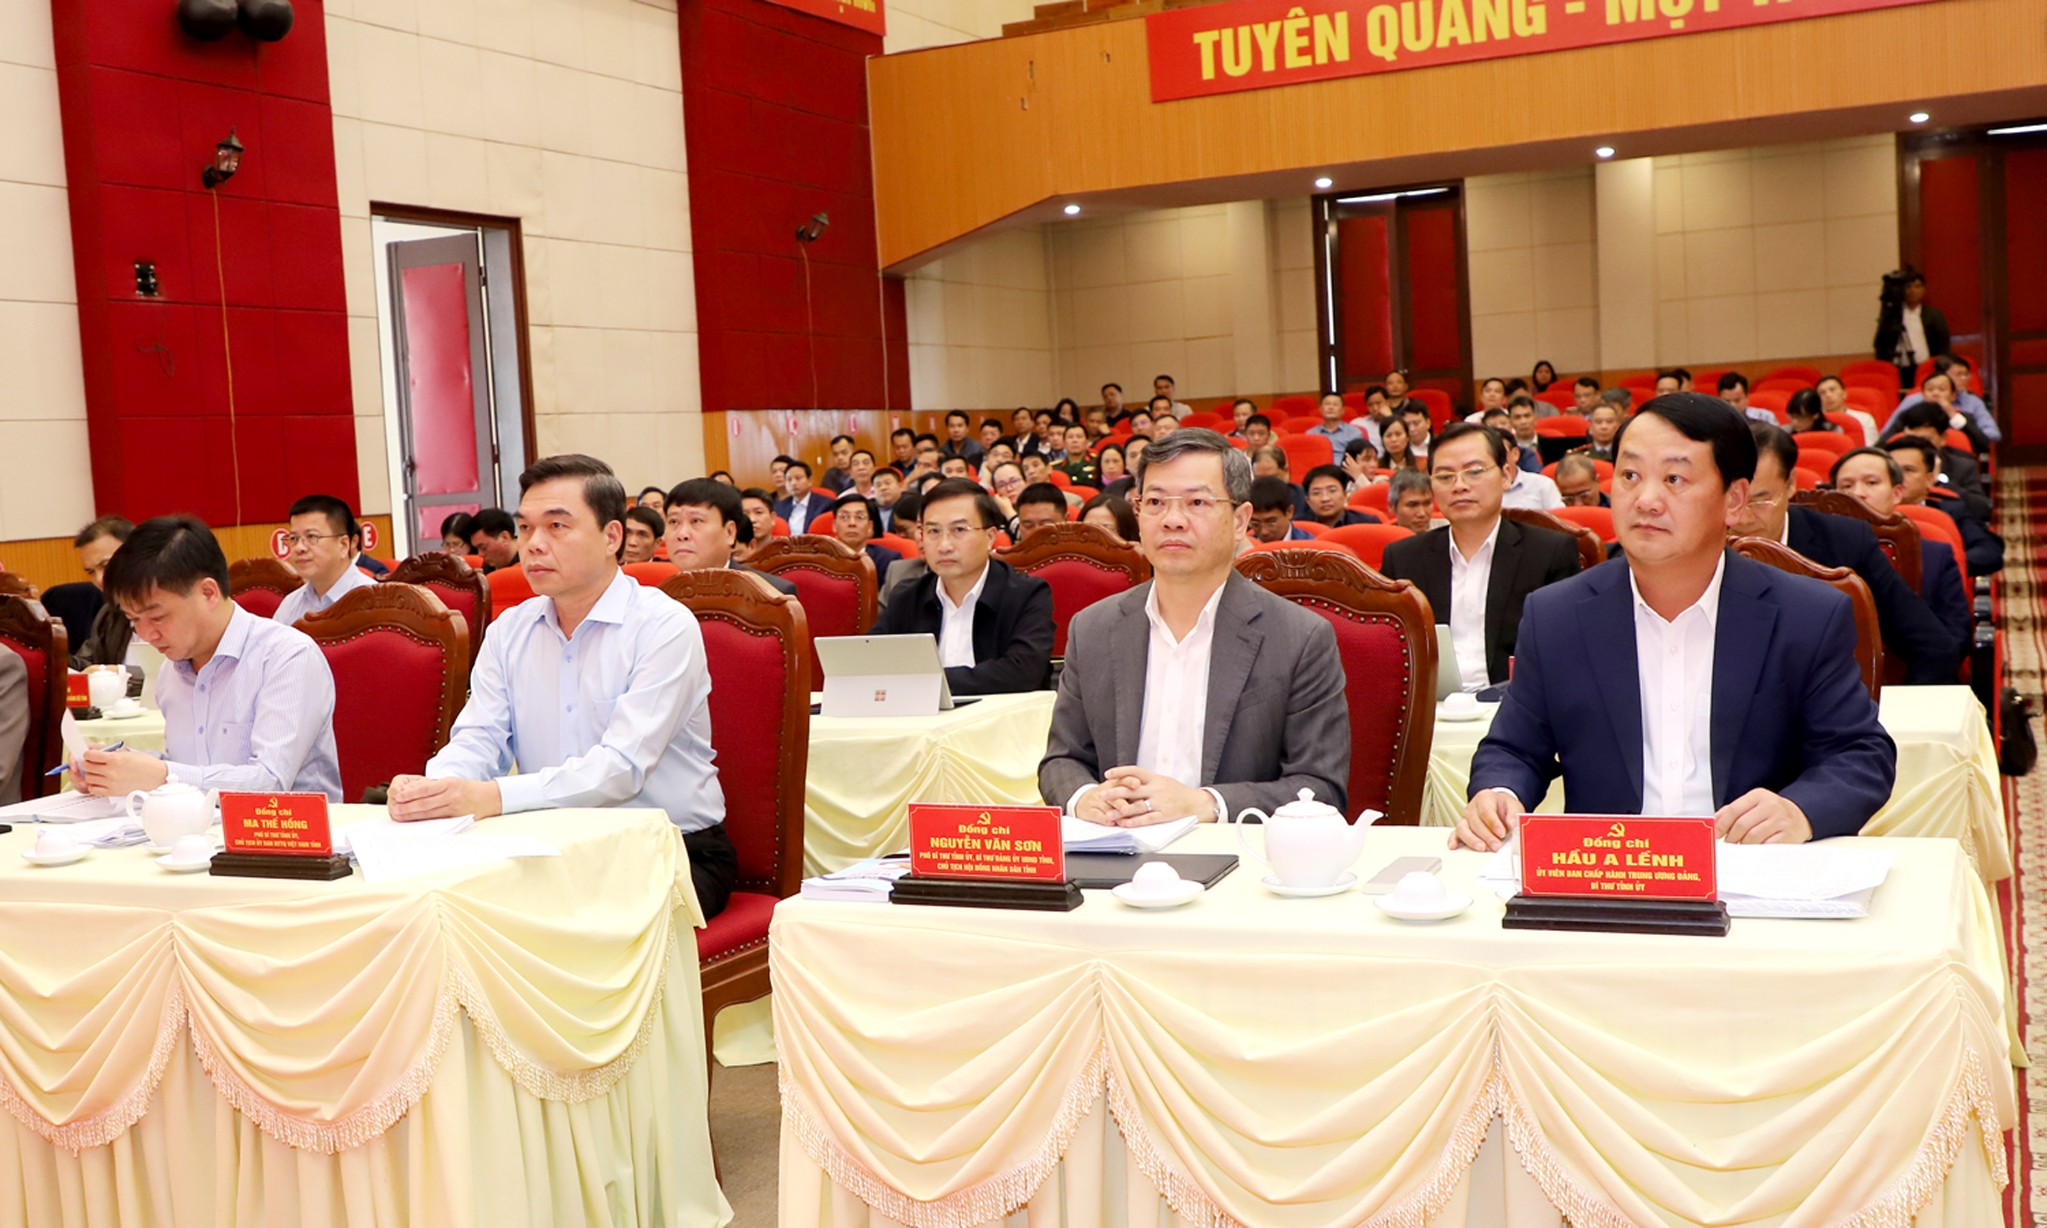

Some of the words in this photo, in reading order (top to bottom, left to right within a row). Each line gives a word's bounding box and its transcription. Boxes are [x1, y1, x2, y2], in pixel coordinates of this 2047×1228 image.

[1193, 6, 1350, 80] TUYÊN
[1366, 0, 1547, 62] QUANG
[363, 526, 373, 547] E
[243, 818, 259, 828] MA
[261, 816, 279, 829] THẾ
[991, 826, 1010, 835] chí
[930, 834, 981, 850] NGUYỄN
[984, 837, 1011, 851] VĂN
[1014, 840, 1042, 852] SƠN
[1625, 838, 1650, 848] chí
[1552, 848, 1597, 865] HẦU
[1603, 853, 1619, 866] A
[1625, 850, 1684, 867] LỀNH
[1566, 869, 1583, 878] BAN
[1628, 870, 1653, 880] TRUNG
